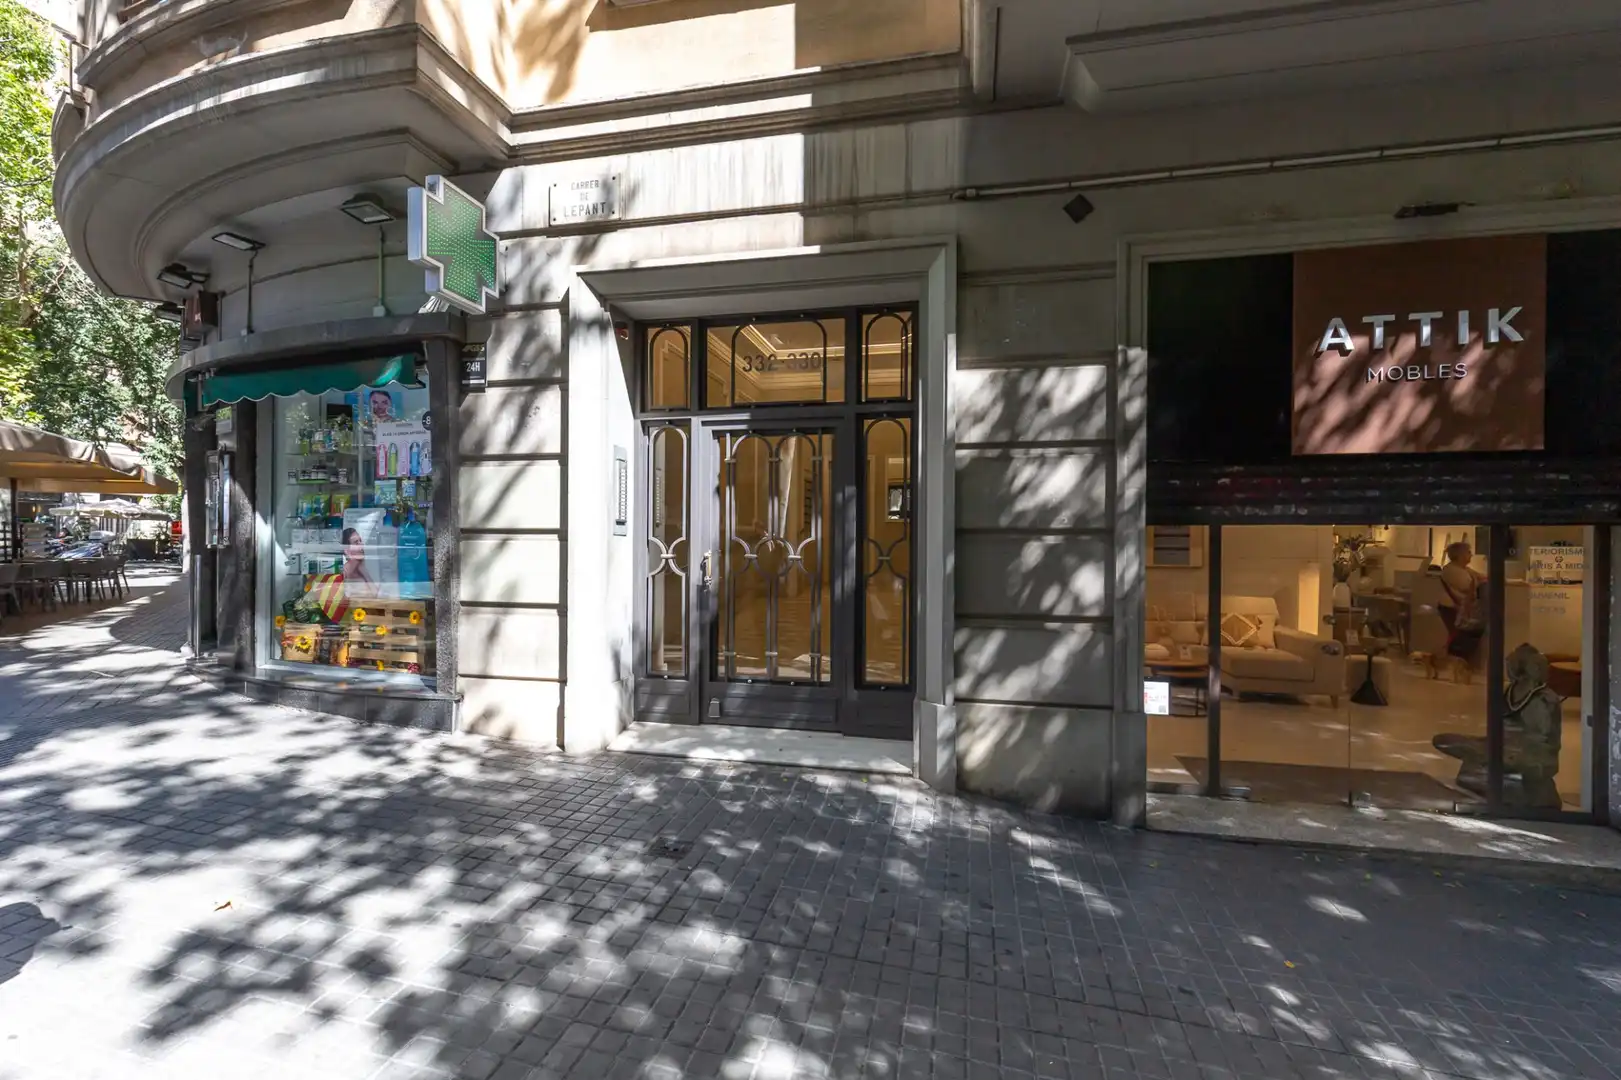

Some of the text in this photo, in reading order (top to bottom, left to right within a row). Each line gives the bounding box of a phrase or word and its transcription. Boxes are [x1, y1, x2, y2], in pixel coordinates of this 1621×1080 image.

[570, 179, 600, 191] CARRER
[580, 191, 589, 201] DE
[563, 202, 607, 218] LEPANT
[1317, 306, 1525, 352] ATTIK
[1366, 362, 1469, 382] MOBLES
